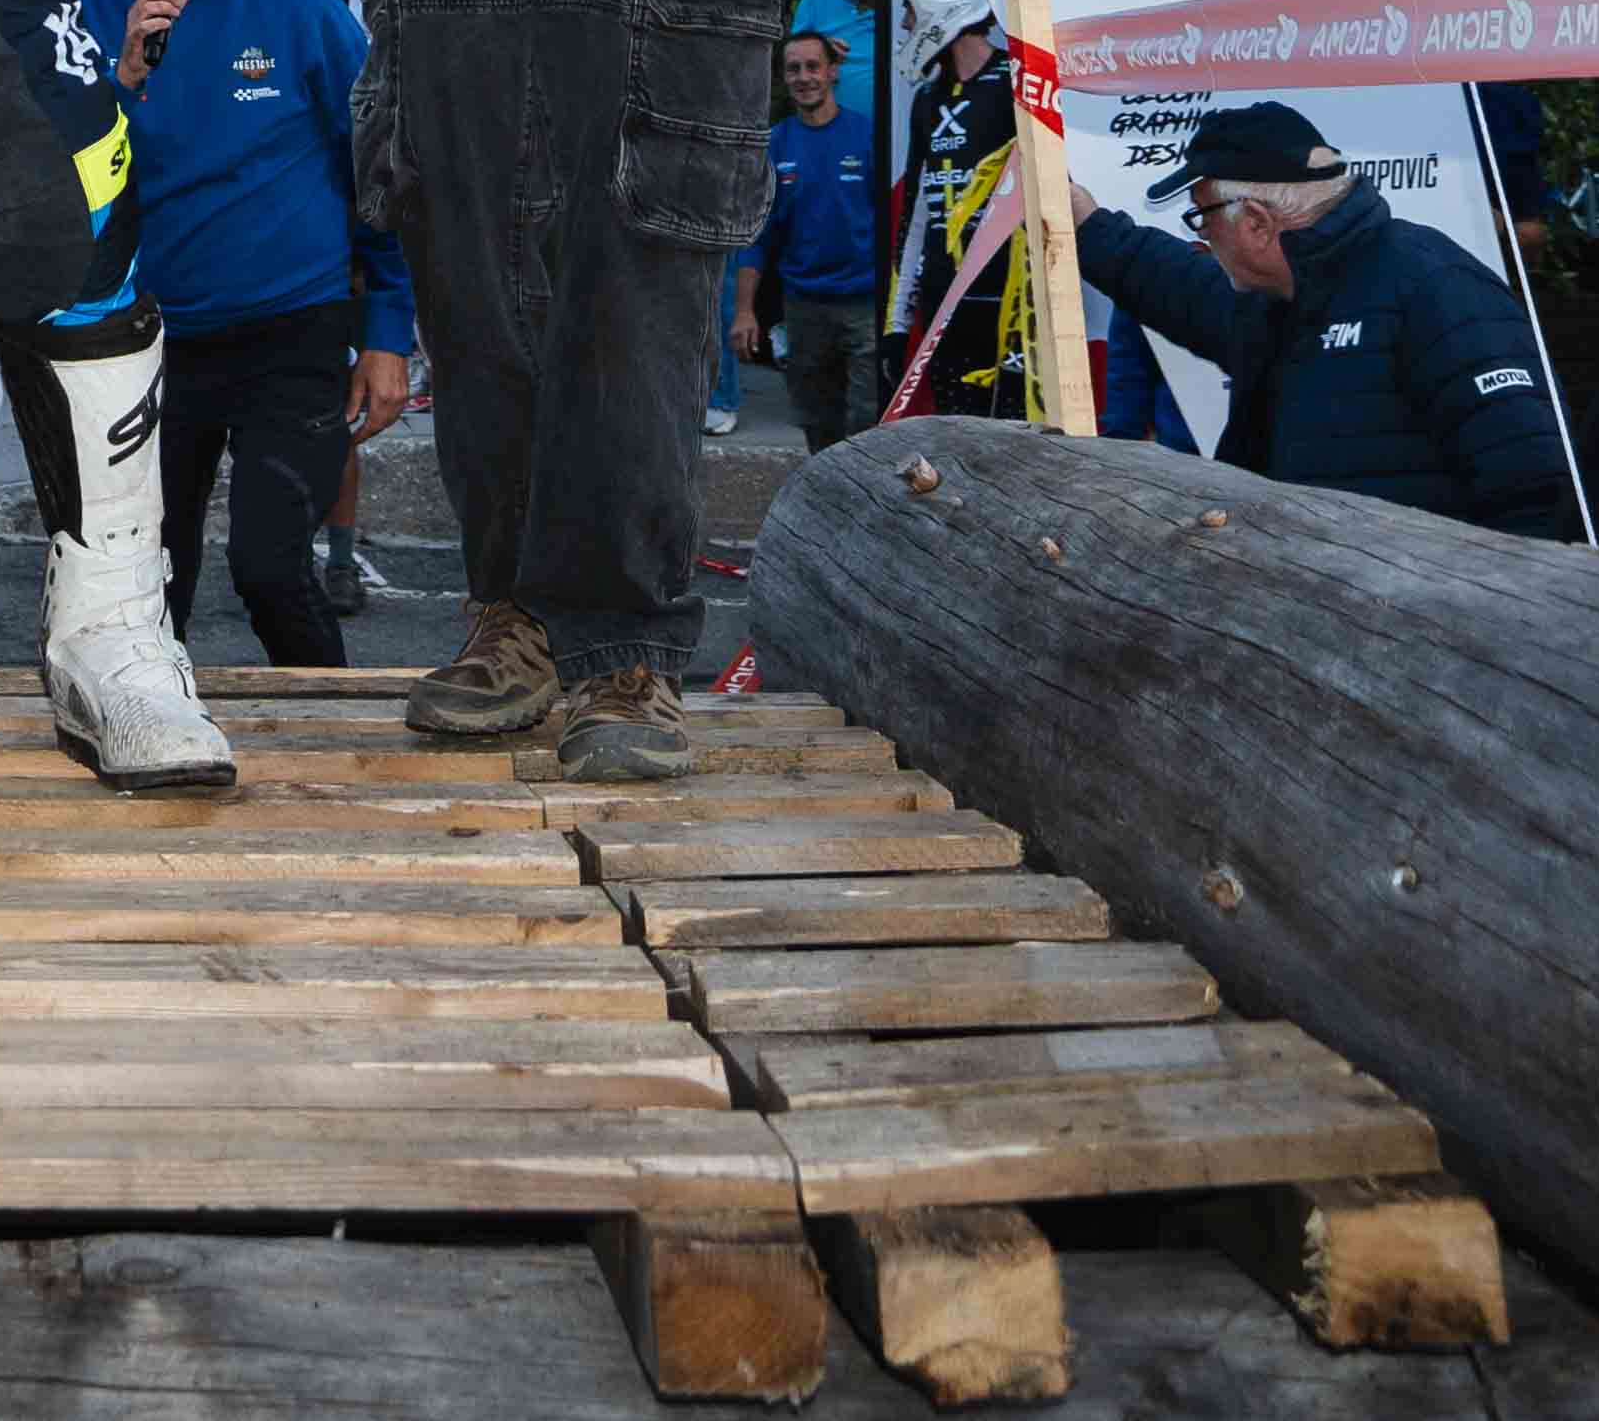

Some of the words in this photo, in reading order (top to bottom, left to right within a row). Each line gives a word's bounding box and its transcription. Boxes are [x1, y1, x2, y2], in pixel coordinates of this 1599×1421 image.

[931, 136, 967, 152] GRIP
[1322, 320, 1363, 348] FIM
[1477, 370, 1532, 392] MOTUL
